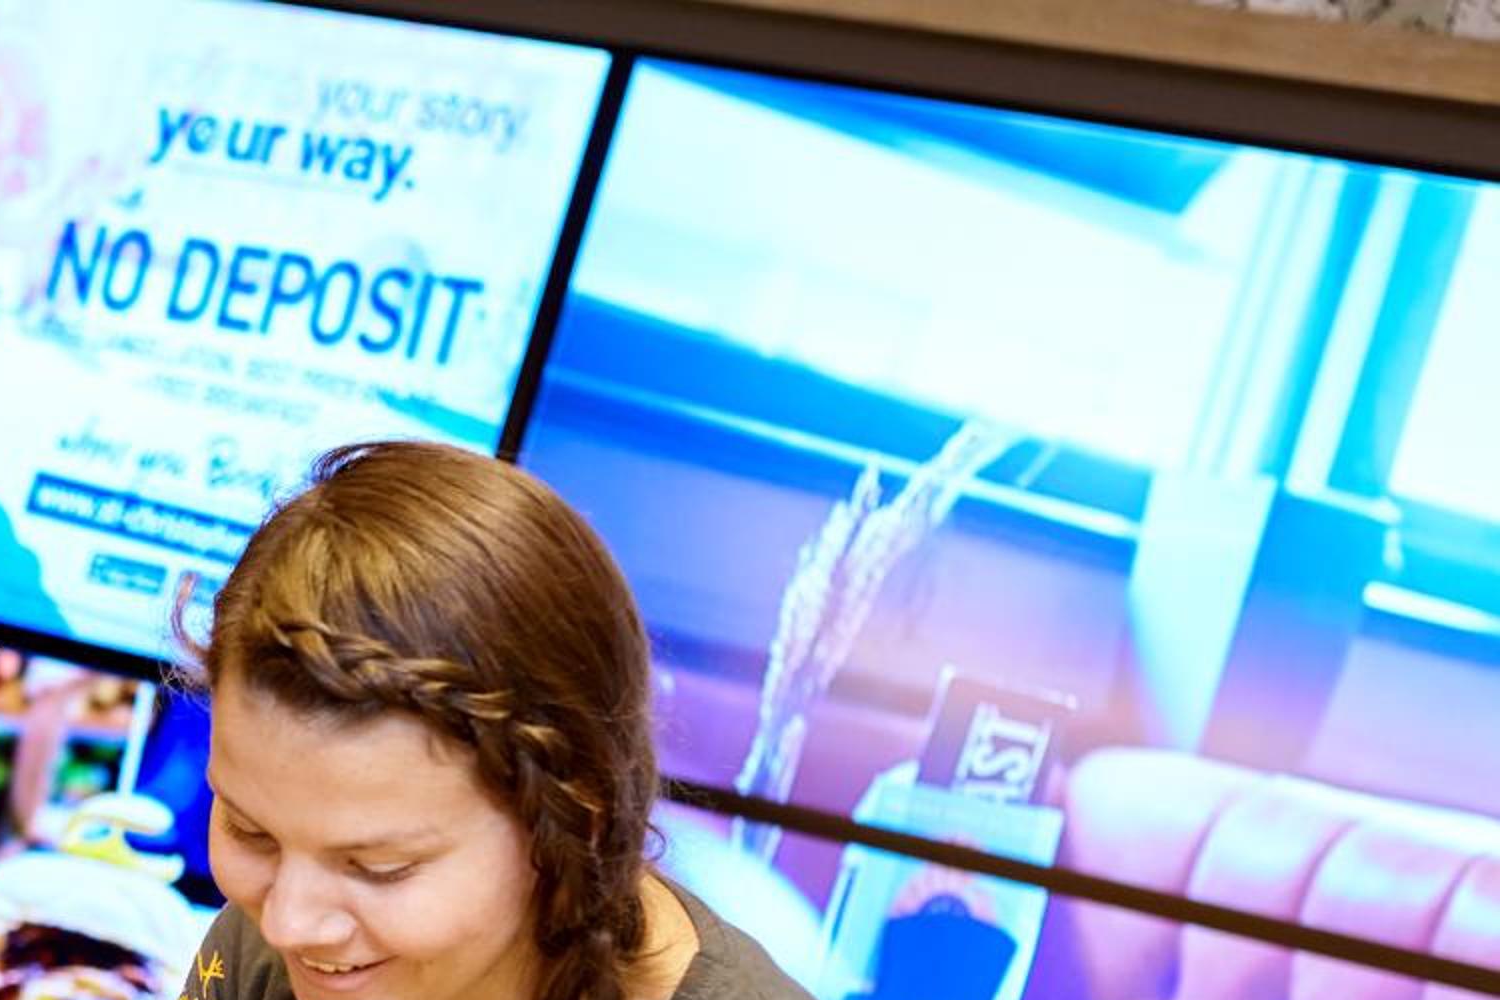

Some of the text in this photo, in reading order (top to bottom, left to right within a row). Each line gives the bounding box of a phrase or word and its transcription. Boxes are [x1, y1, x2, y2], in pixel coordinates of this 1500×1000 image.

[150, 106, 415, 201] your way.
[46, 220, 485, 366] NO DEPOSIT
